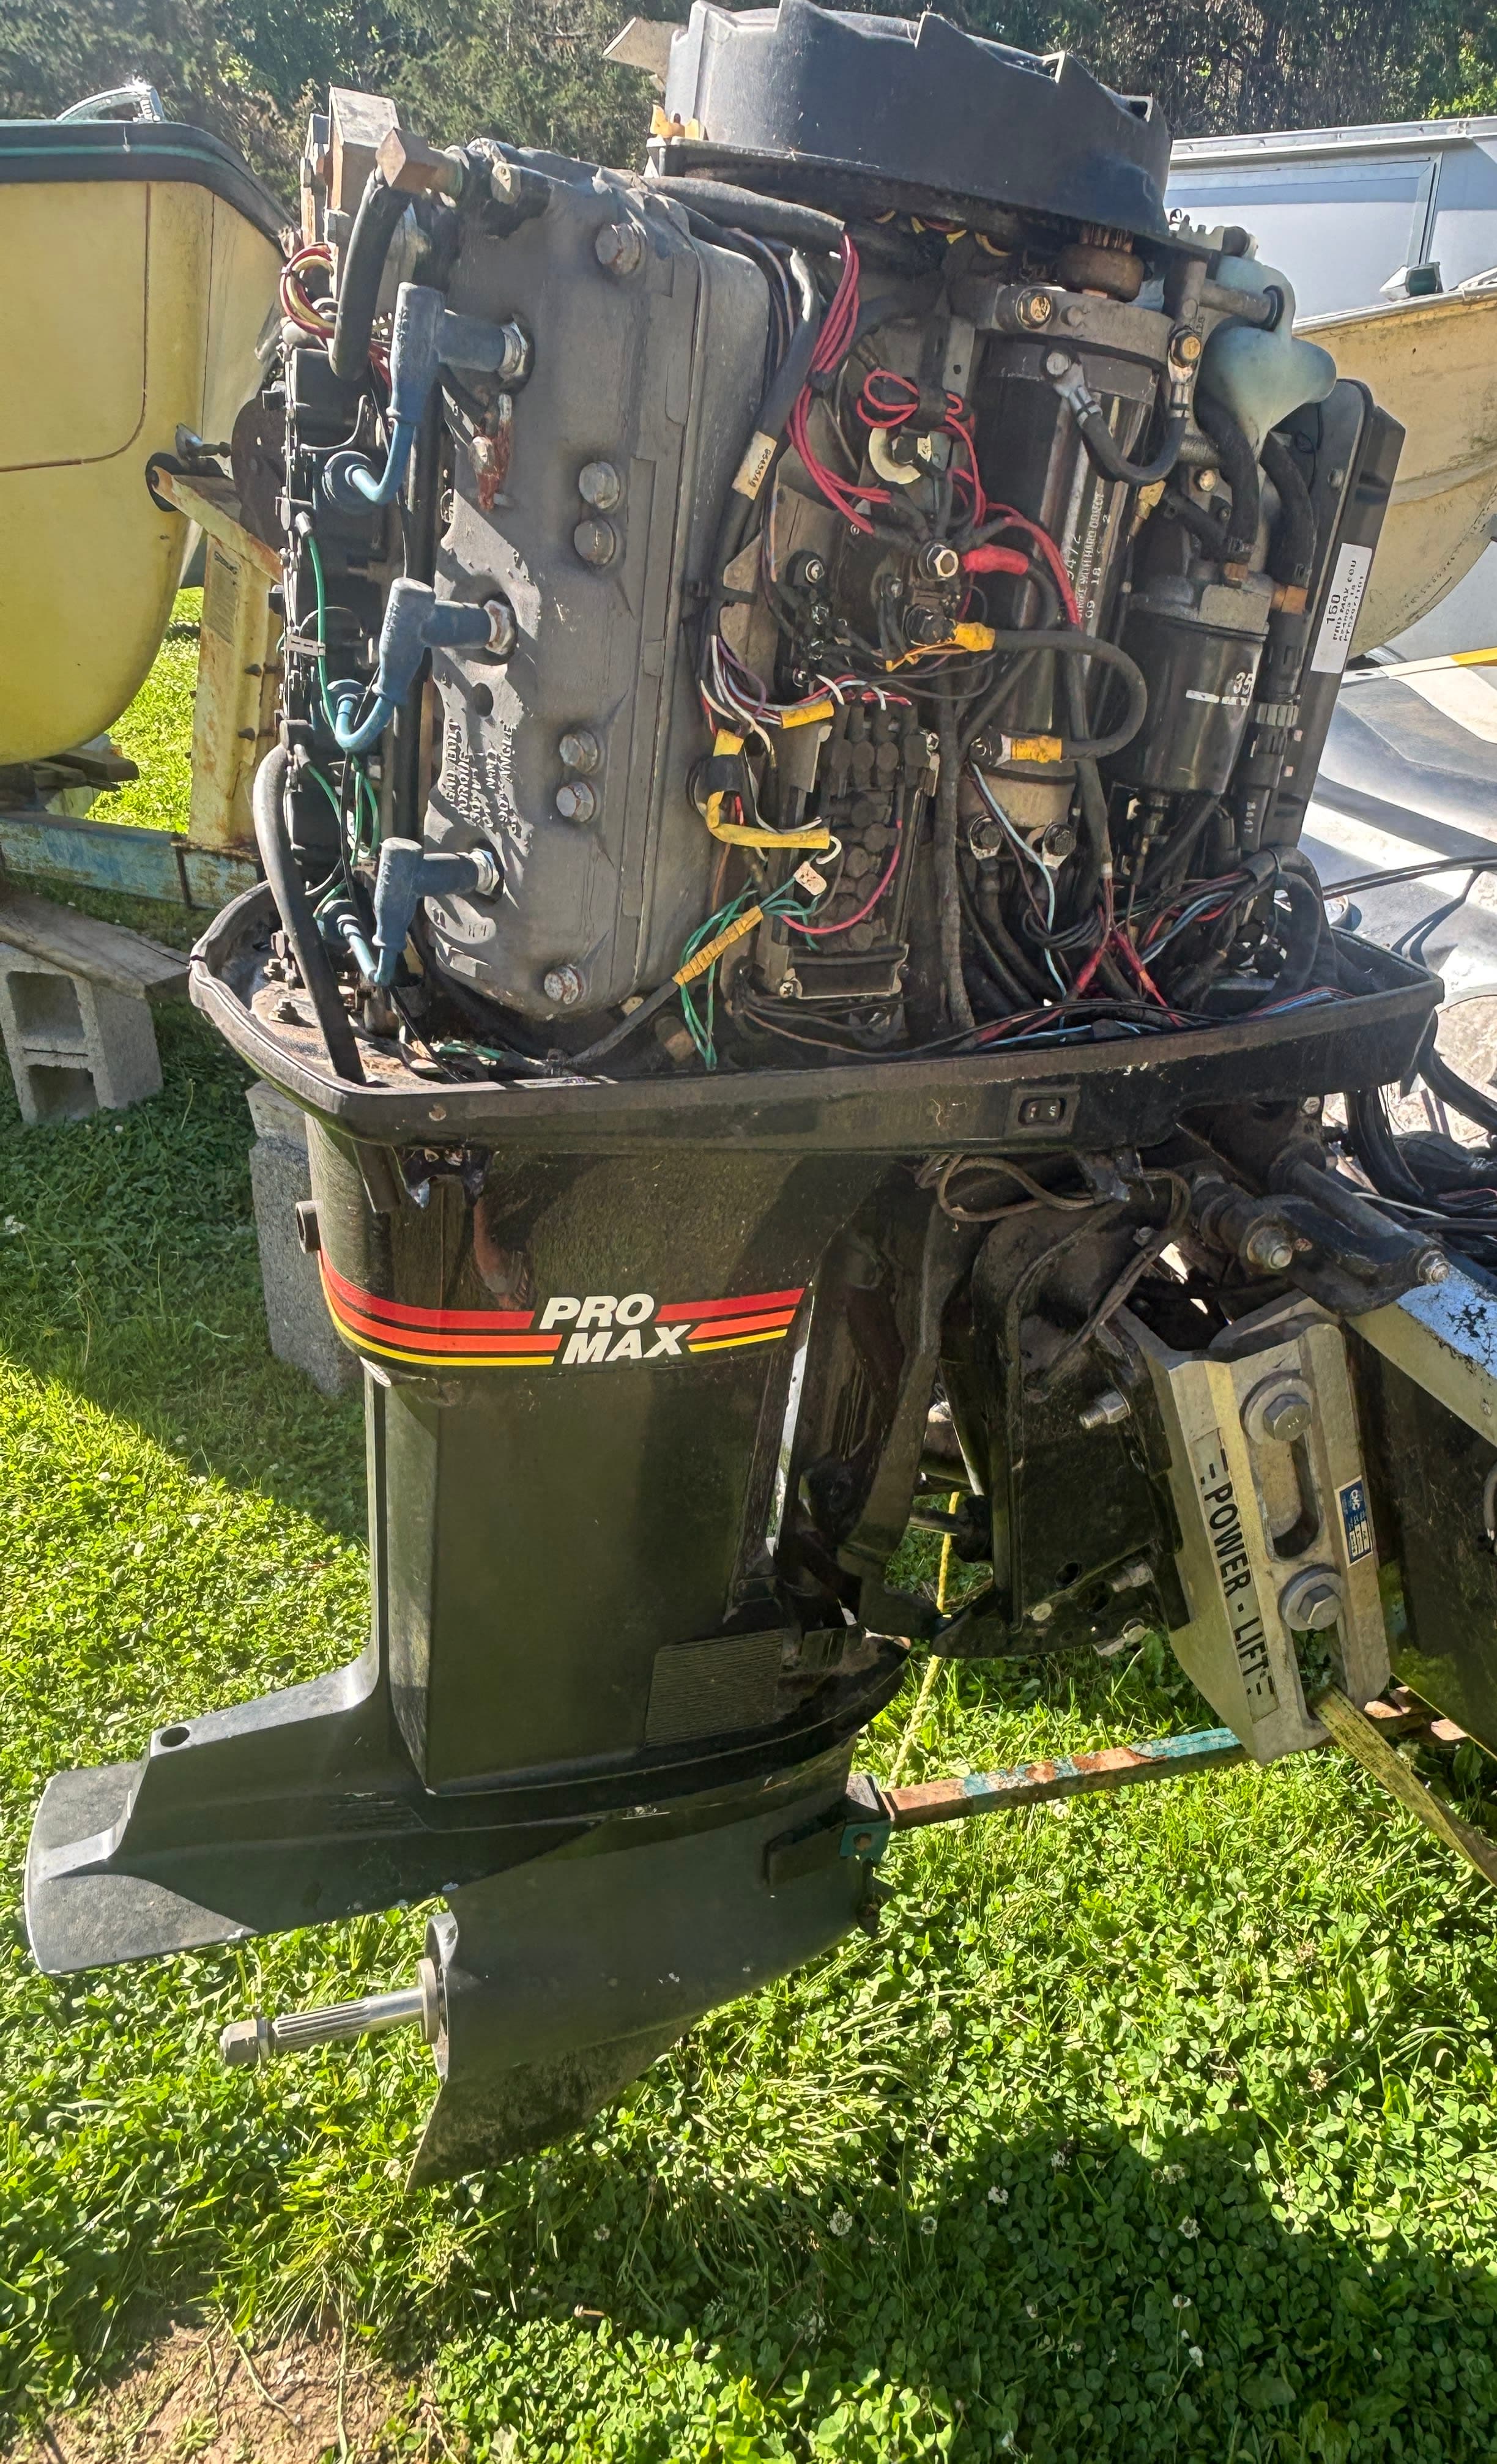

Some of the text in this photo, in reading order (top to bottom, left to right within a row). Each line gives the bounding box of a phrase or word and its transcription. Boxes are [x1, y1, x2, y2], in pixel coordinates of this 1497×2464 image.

[1326, 595, 1340, 625] 150
[539, 1293, 655, 1329] PRO
[561, 1324, 691, 1364] MAX
[1204, 1481, 1252, 1598] POWER
[1233, 1616, 1269, 1676] LIFT
